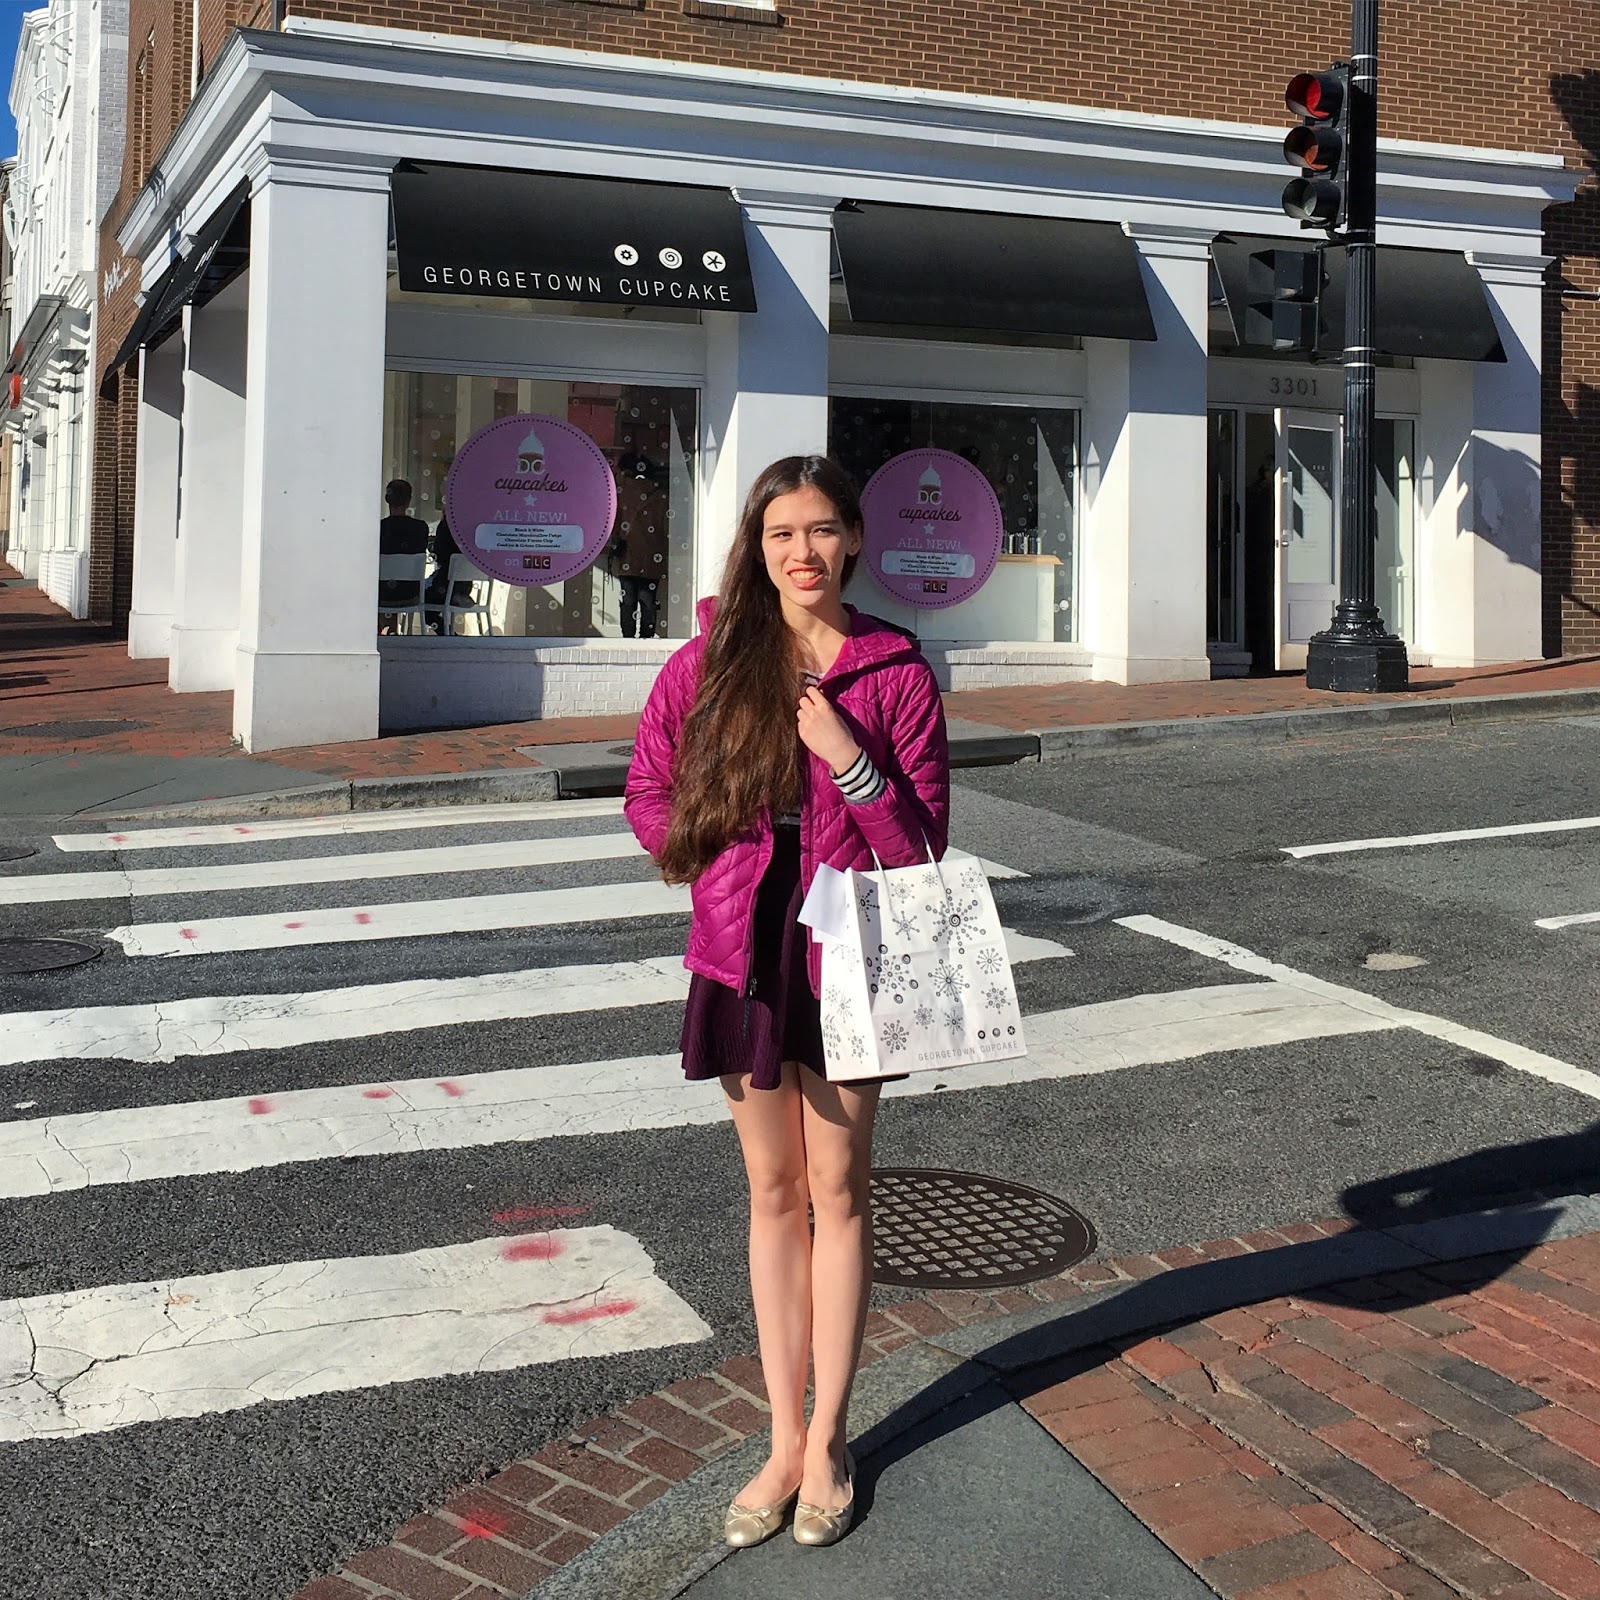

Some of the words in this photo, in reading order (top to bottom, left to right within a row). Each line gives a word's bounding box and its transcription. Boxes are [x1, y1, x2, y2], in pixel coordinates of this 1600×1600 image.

[423, 265, 602, 293] GEORGETOWN
[619, 278, 731, 302] CUPCAKE
[1269, 377, 1317, 396] 3301
[515, 457, 545, 474] DC
[494, 473, 568, 495] cupcakes
[916, 490, 942, 505] DC
[493, 509, 523, 522] ALL
[526, 510, 567, 523] NEW!
[898, 504, 962, 524] cupcakes
[897, 538, 923, 549] ALL
[926, 539, 961, 550] NEW!
[505, 557, 520, 566] on
[523, 556, 550, 568] TLC
[906, 582, 920, 590] on
[923, 580, 947, 593] TLC
[918, 1047, 976, 1061] GEORGETOWN
[980, 1041, 1018, 1053] CUPCAKE
